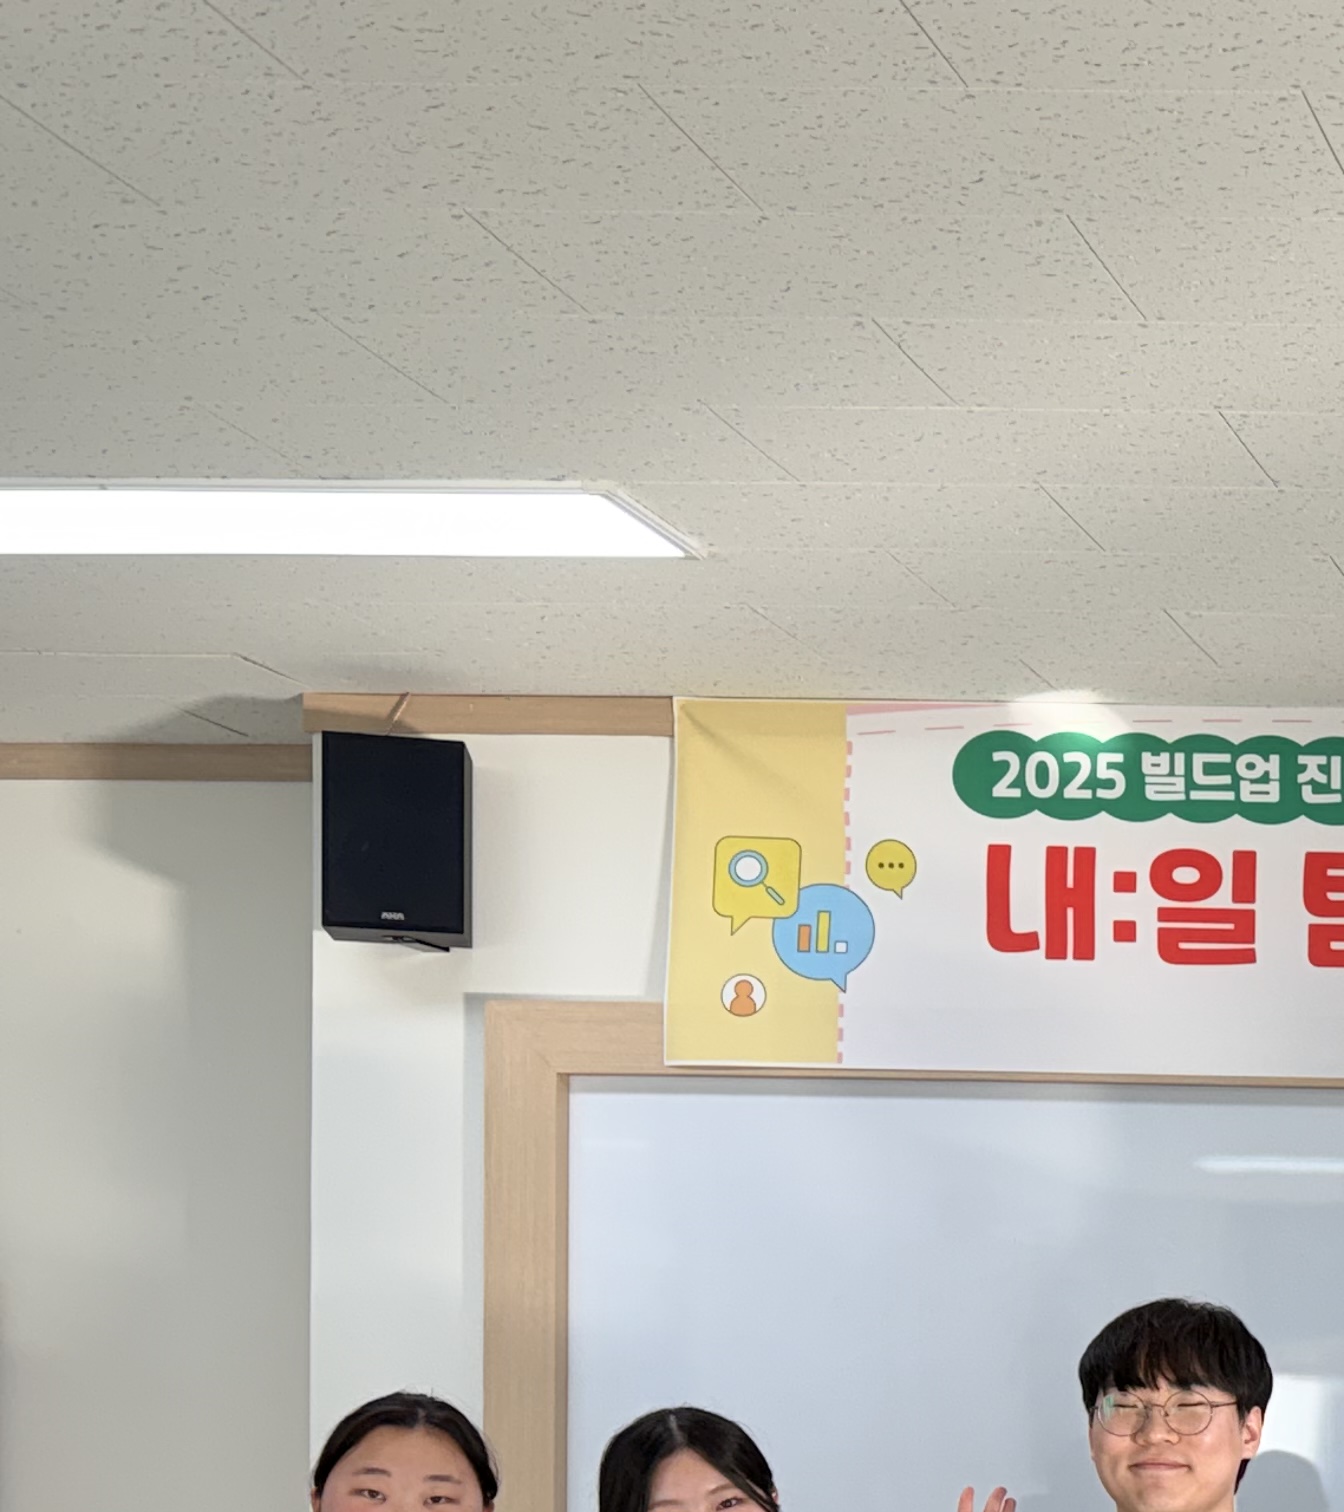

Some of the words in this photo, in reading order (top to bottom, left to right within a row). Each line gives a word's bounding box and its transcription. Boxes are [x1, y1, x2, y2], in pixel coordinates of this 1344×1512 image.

[991, 750, 1126, 800] 2025
[1141, 751, 1280, 804] 빌드업
[985, 842, 1258, 966] 내:일
